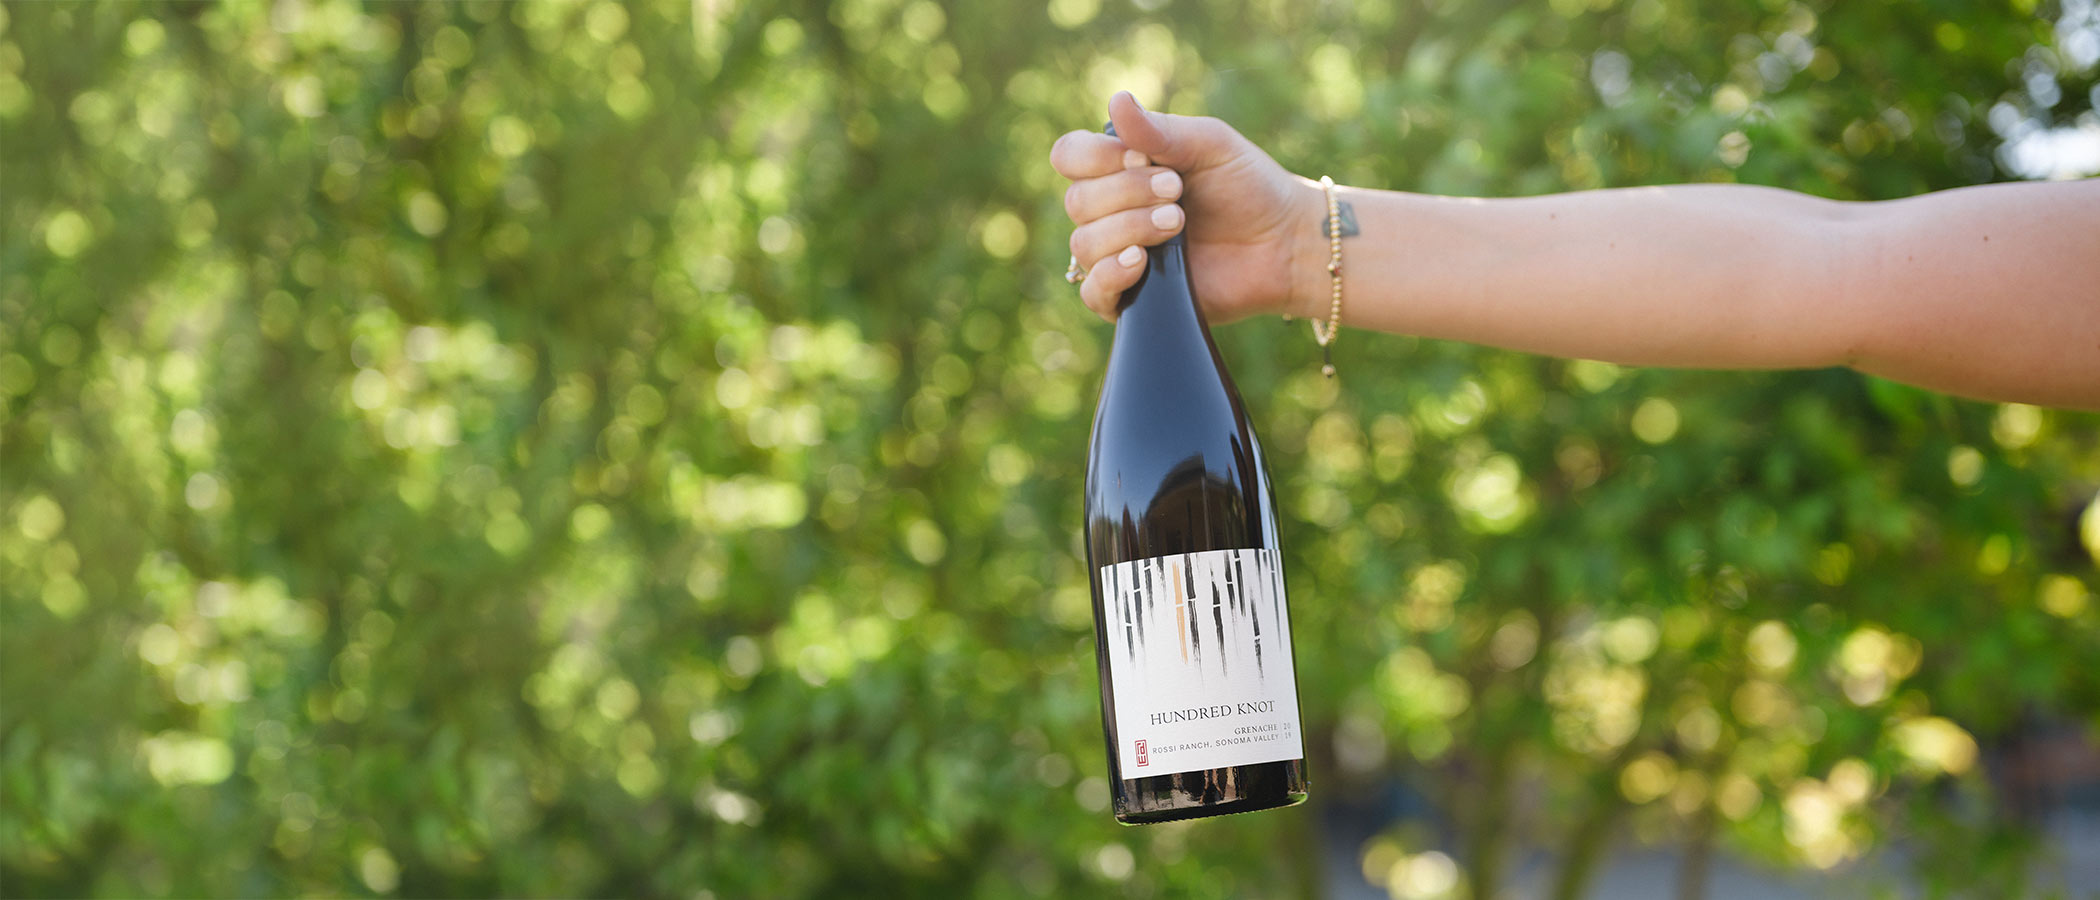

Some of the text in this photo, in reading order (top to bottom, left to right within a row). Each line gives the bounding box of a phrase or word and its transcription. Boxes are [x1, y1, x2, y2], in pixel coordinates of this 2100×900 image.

[1150, 700, 1276, 726] HUNDRED KNOT
[1234, 723, 1278, 735] GRENACHE
[1152, 733, 1280, 755] ROSSI RANCH, SONOMA VALLEY
